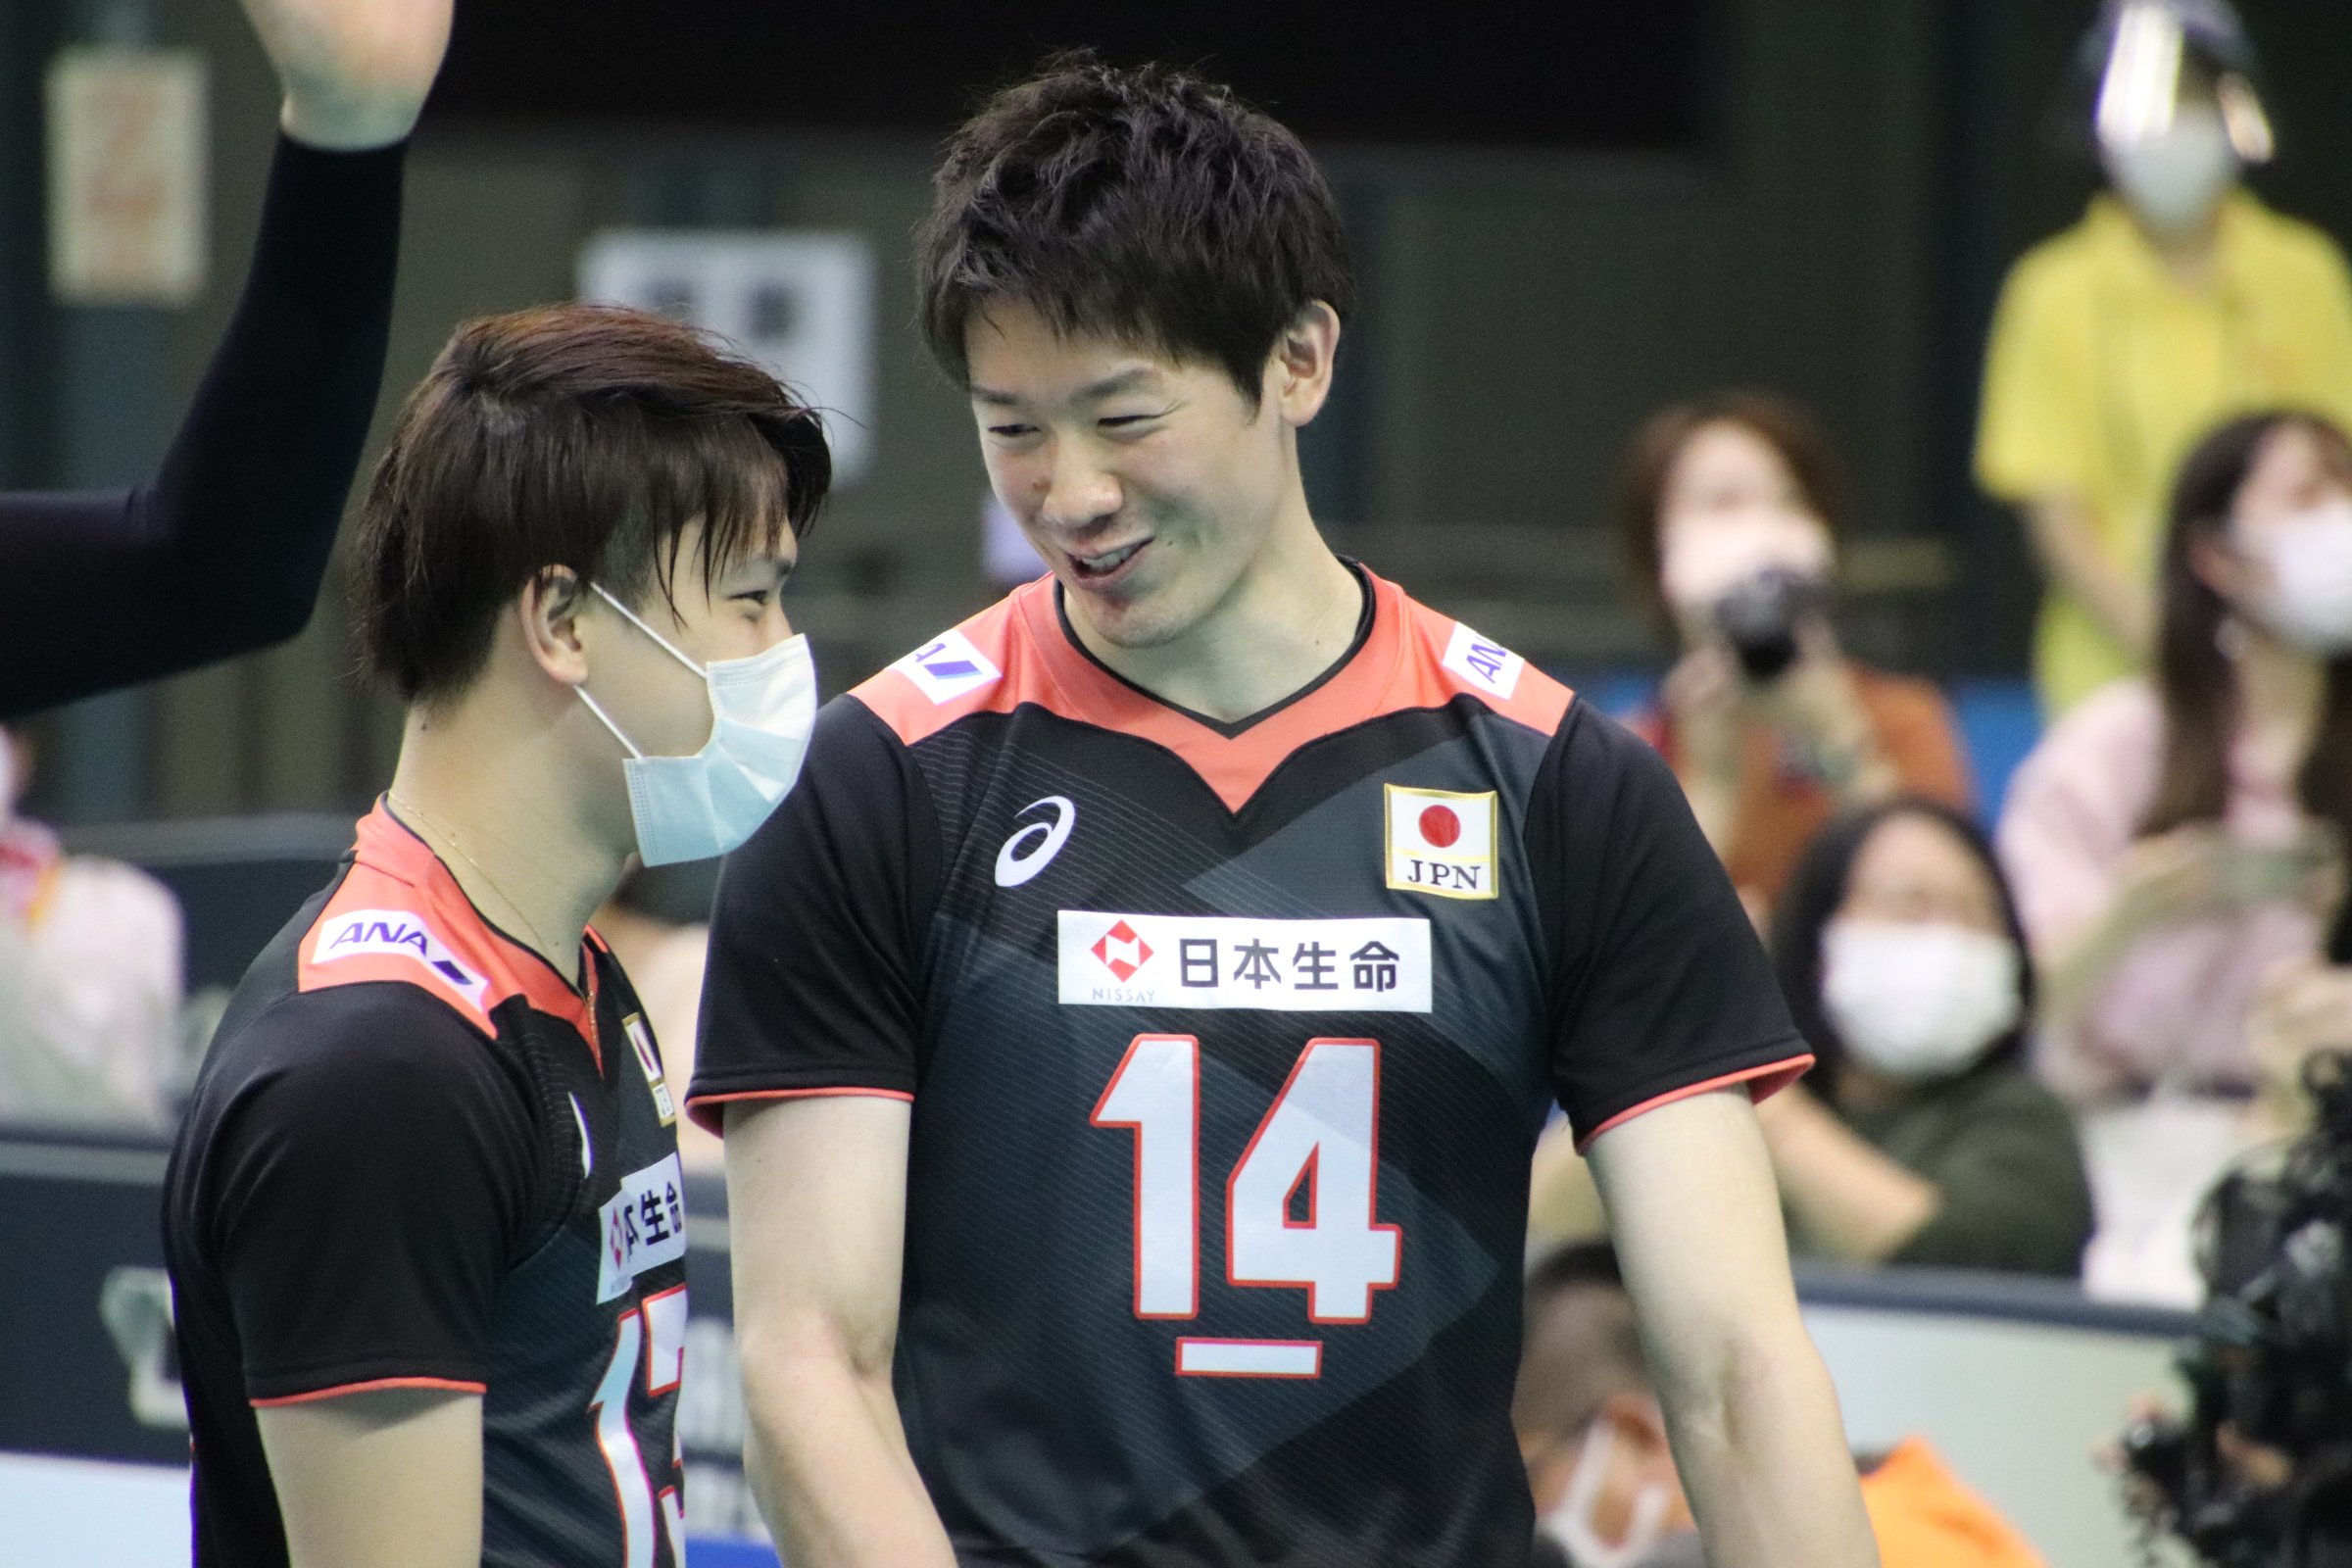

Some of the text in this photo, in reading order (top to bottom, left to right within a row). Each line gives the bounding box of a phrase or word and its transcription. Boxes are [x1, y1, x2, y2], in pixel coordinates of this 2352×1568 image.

[1407, 859, 1481, 890] JPN
[328, 921, 428, 956] ANA
[1179, 937, 1400, 993] 日本生命
[1092, 987, 1155, 1003] NISSAY
[1090, 1033, 1402, 1323] 14
